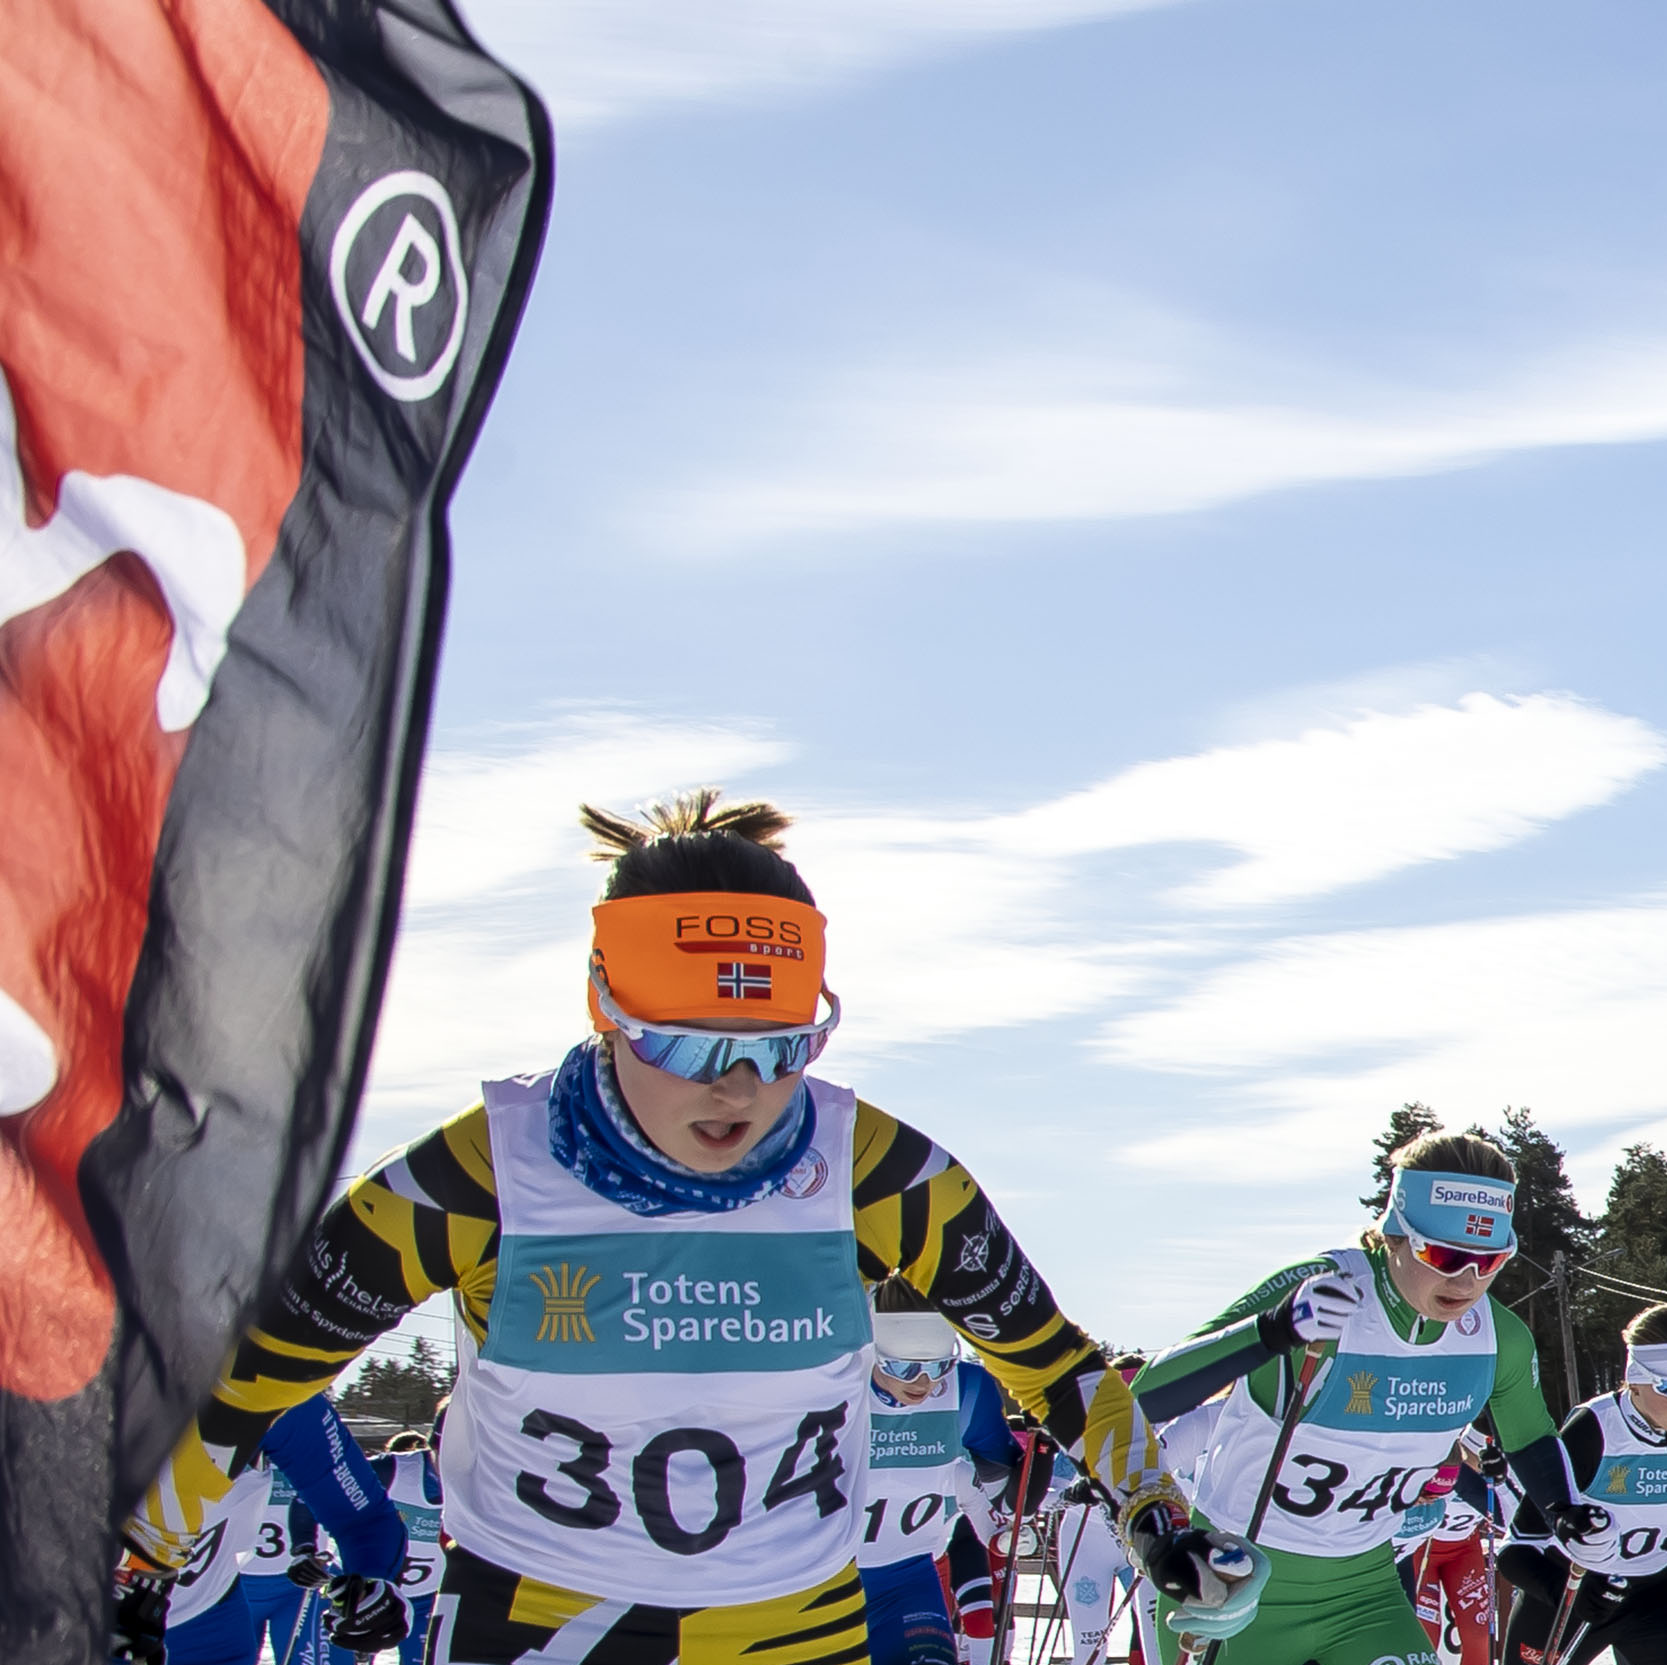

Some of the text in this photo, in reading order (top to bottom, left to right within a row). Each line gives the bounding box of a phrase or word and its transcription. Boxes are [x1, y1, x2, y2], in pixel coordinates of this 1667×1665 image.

[676, 915, 802, 944] FOSS
[750, 943, 803, 959] sport
[1434, 1186, 1506, 1210] SpareBank
[624, 1271, 761, 1305] Totens
[622, 1307, 834, 1350] Sparebank
[1387, 1376, 1448, 1397] Totens
[1384, 1394, 1475, 1418] Sparebank
[871, 1429, 918, 1442] Totens
[869, 1441, 946, 1460] Sparebank
[515, 1401, 849, 1556] 304
